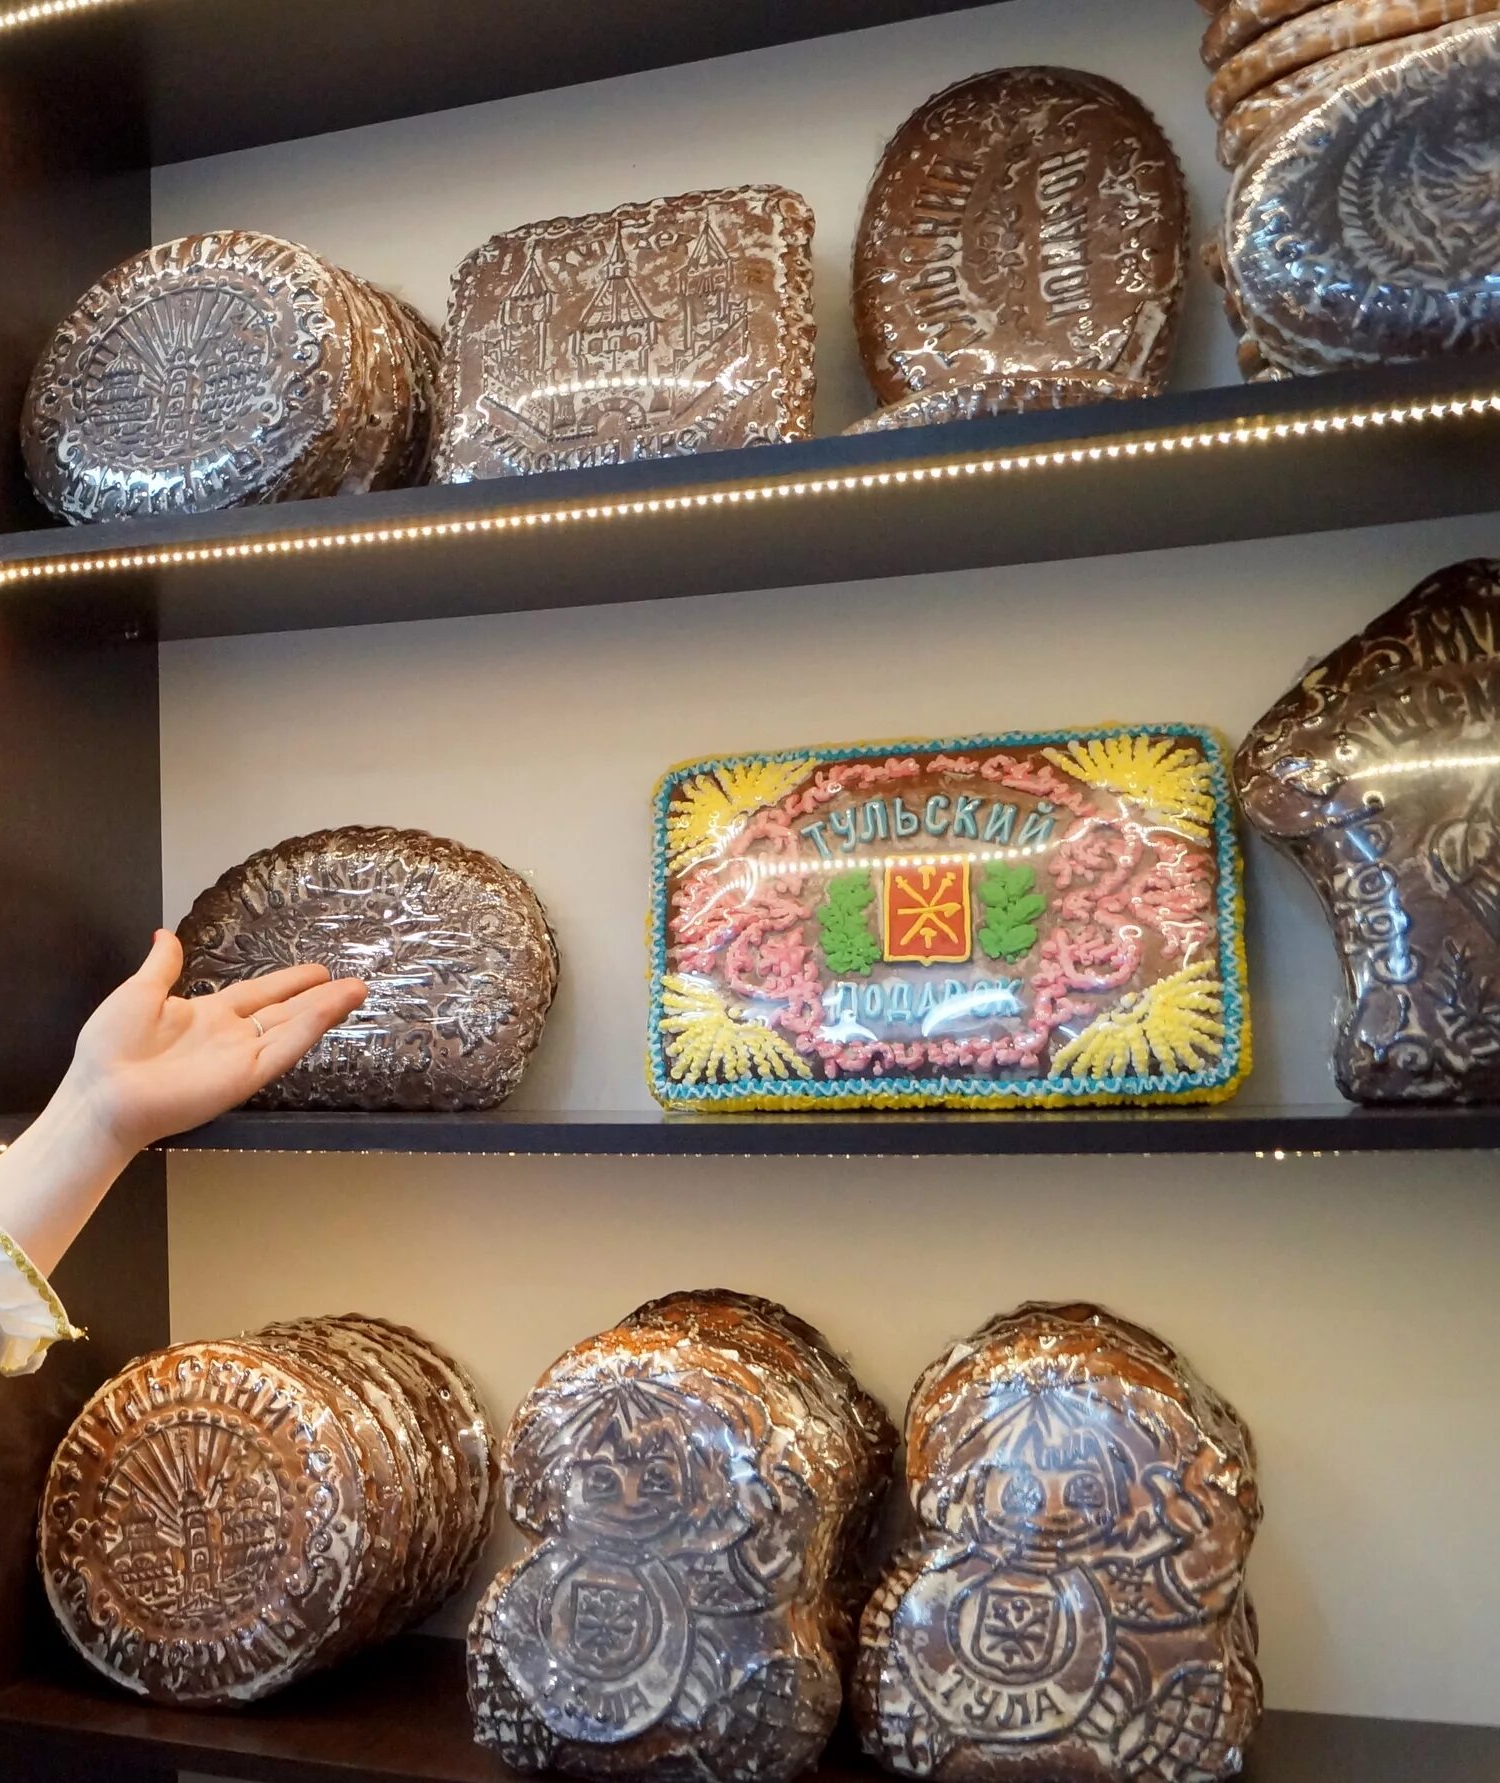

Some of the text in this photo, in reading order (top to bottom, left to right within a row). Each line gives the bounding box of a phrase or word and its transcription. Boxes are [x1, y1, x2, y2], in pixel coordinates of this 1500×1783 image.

[800, 793, 1060, 861] ТУЛЬСКИЙ
[832, 978, 1024, 1022] ПОДАРОК
[938, 1667, 1064, 1731] ТУЛА
